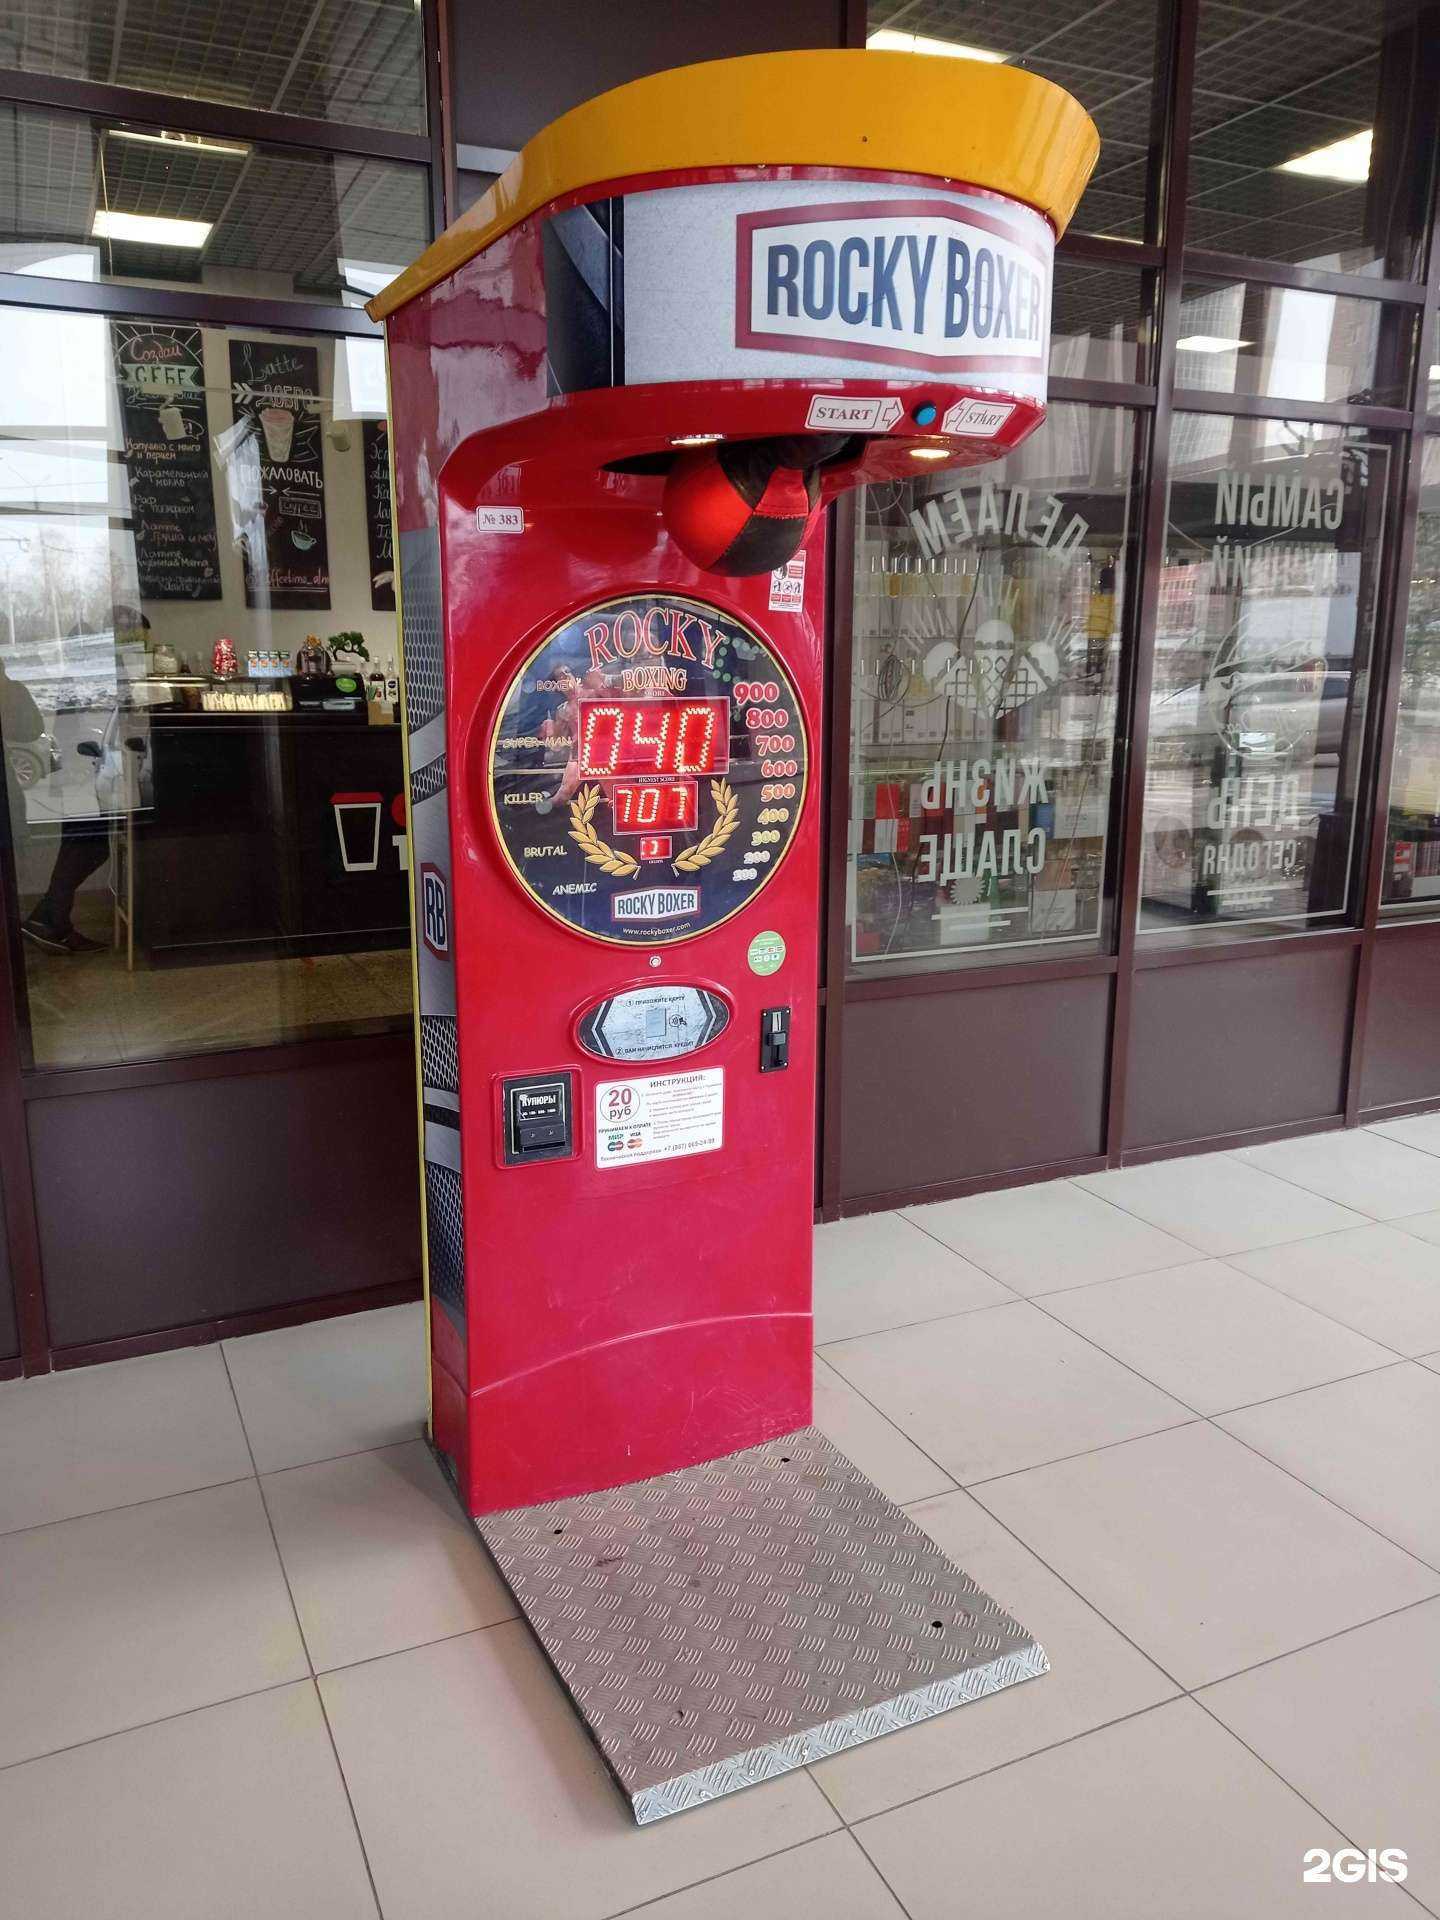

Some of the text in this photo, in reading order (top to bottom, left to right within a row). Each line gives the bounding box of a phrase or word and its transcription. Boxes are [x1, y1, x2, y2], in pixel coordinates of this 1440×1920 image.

[767, 234, 1042, 341] ROCKY BOXER
[816, 407, 873, 421] START
[965, 410, 1004, 426] START
[483, 514, 519, 525] № 383
[583, 606, 727, 673] ROCKY
[621, 665, 688, 692] BOXING
[733, 682, 779, 705] 900
[746, 708, 788, 728] 800
[581, 707, 716, 775] 040
[756, 735, 795, 756] 700
[761, 760, 798, 777] 600
[504, 792, 543, 805] KILLER
[761, 783, 795, 802] 500
[617, 786, 689, 823] 707
[758, 808, 789, 825] 400
[751, 830, 780, 846] 300
[524, 845, 567, 857] BRUTAL
[553, 883, 597, 896] ANEMIC
[425, 878, 446, 945] RB
[617, 892, 695, 915] ROCKY BOXER
[622, 922, 691, 936] www.rockyboxer.com
[650, 1074, 707, 1088] ИНСТРУКЦИЯ:
[608, 1088, 632, 1107] 20
[609, 1105, 632, 1119] руб
